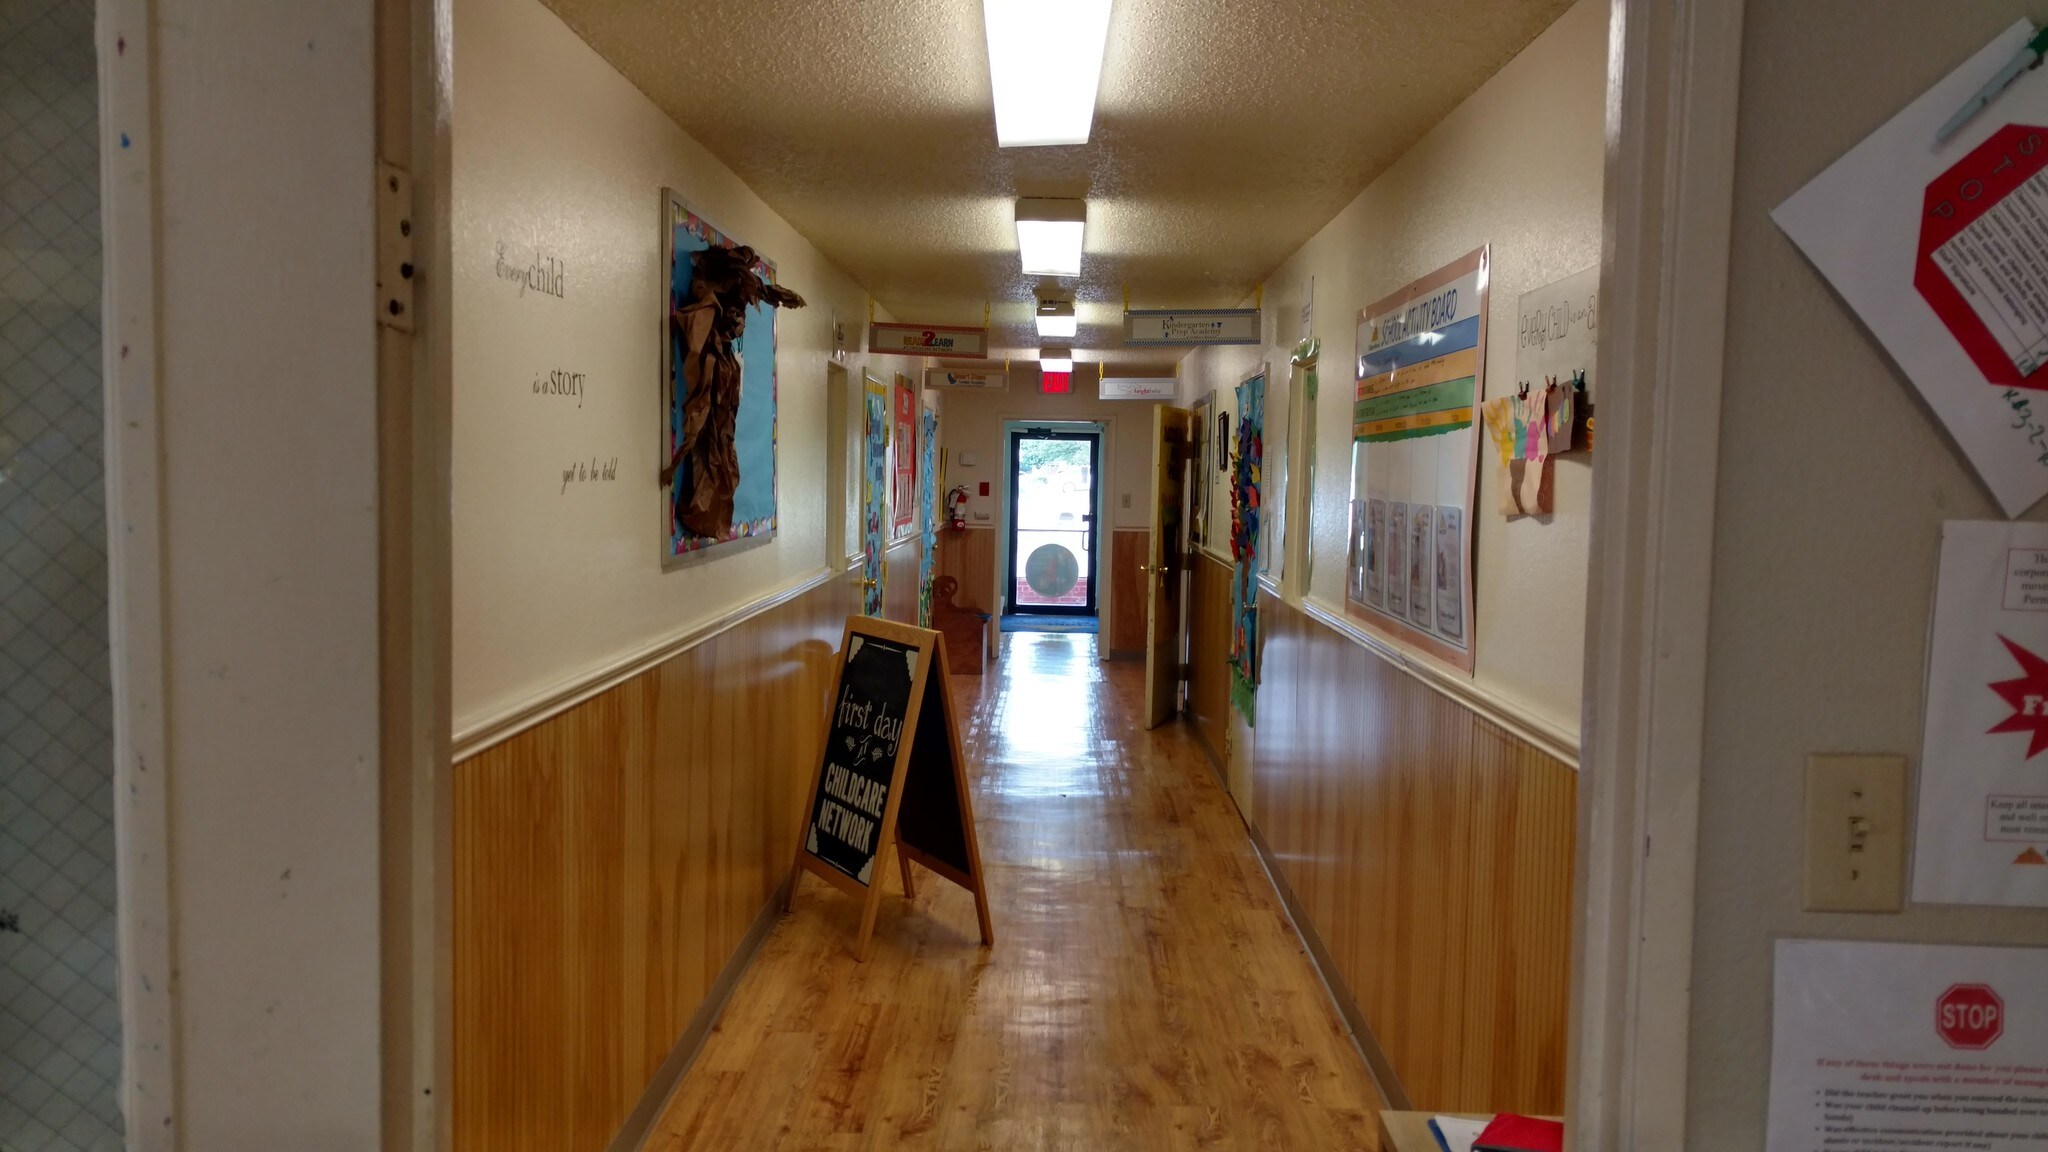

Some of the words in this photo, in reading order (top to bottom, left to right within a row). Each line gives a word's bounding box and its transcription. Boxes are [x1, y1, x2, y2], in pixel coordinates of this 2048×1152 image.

[1950, 265, 1976, 296] Signature
[1981, 267, 2004, 294] personal
[1162, 319, 1210, 330] Kindergarten
[1402, 300, 1431, 338] ACTIVITY
[1431, 288, 1458, 328] BOARD
[1171, 328, 1188, 336] Prep
[1191, 328, 1221, 336] Academy
[550, 369, 586, 409] story
[1043, 372, 1069, 393] EXIT
[561, 462, 577, 495] yet
[590, 457, 599, 482] be
[602, 457, 618, 481] told
[838, 685, 873, 734] first
[873, 702, 902, 757] day
[824, 761, 887, 820] CHILDCARE
[818, 798, 874, 856] NETWORK
[1942, 1003, 1997, 1030] STOP
